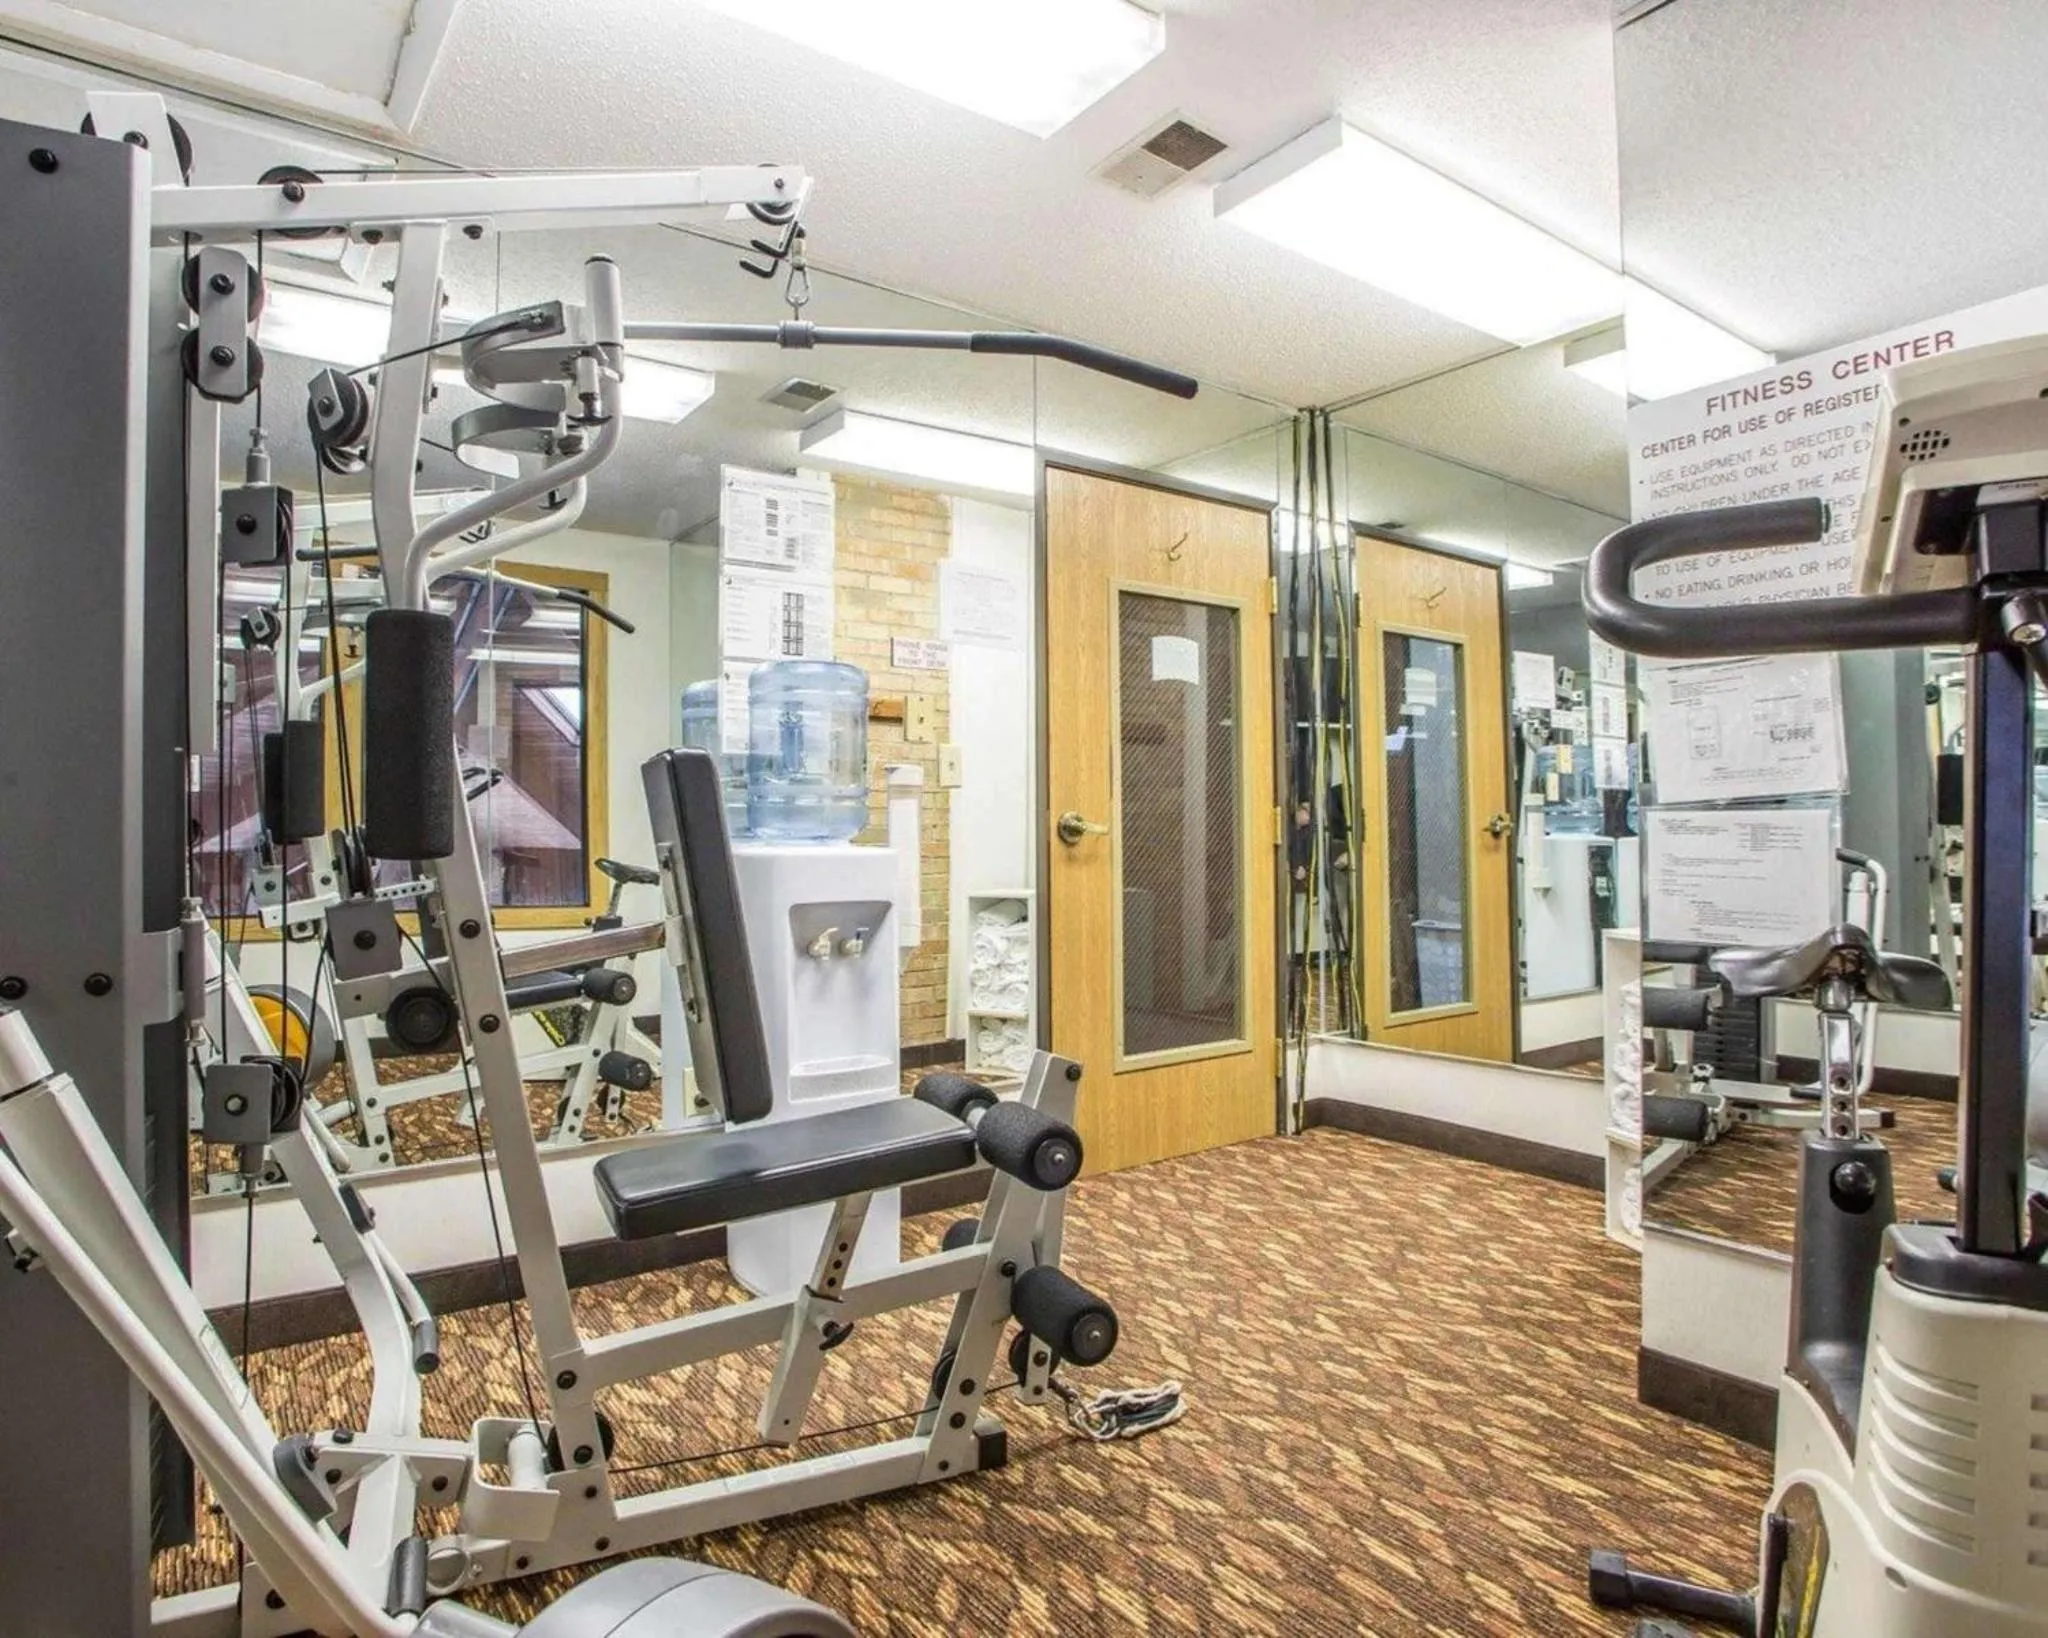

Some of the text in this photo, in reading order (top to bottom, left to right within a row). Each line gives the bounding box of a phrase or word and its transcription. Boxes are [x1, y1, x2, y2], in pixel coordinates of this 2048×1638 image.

[1706, 329, 1955, 417] FITNESS CENTER
[1641, 433, 1696, 459] CENTER
[1702, 424, 1732, 444] FOR
[1738, 414, 1769, 434] USE
[1775, 407, 1797, 424] OF
[1650, 468, 1675, 485] USE
[1680, 448, 1752, 479] EQUIPMENT
[1760, 443, 1778, 457] AS
[1784, 424, 1855, 453] DIRECTED
[1650, 470, 1739, 500] INSTRUCTIONS
[1791, 453, 1810, 468] DO
[1818, 443, 1845, 461] NOT
[1743, 483, 1790, 502] UNDER
[1797, 474, 1825, 491] THE
[1832, 466, 1861, 485] AGE
[1655, 587, 1673, 599] NO
[1800, 561, 1820, 575] OR
[1827, 557, 1852, 571] HO
[1676, 558, 1699, 572] USE
[1707, 555, 1725, 567] OF
